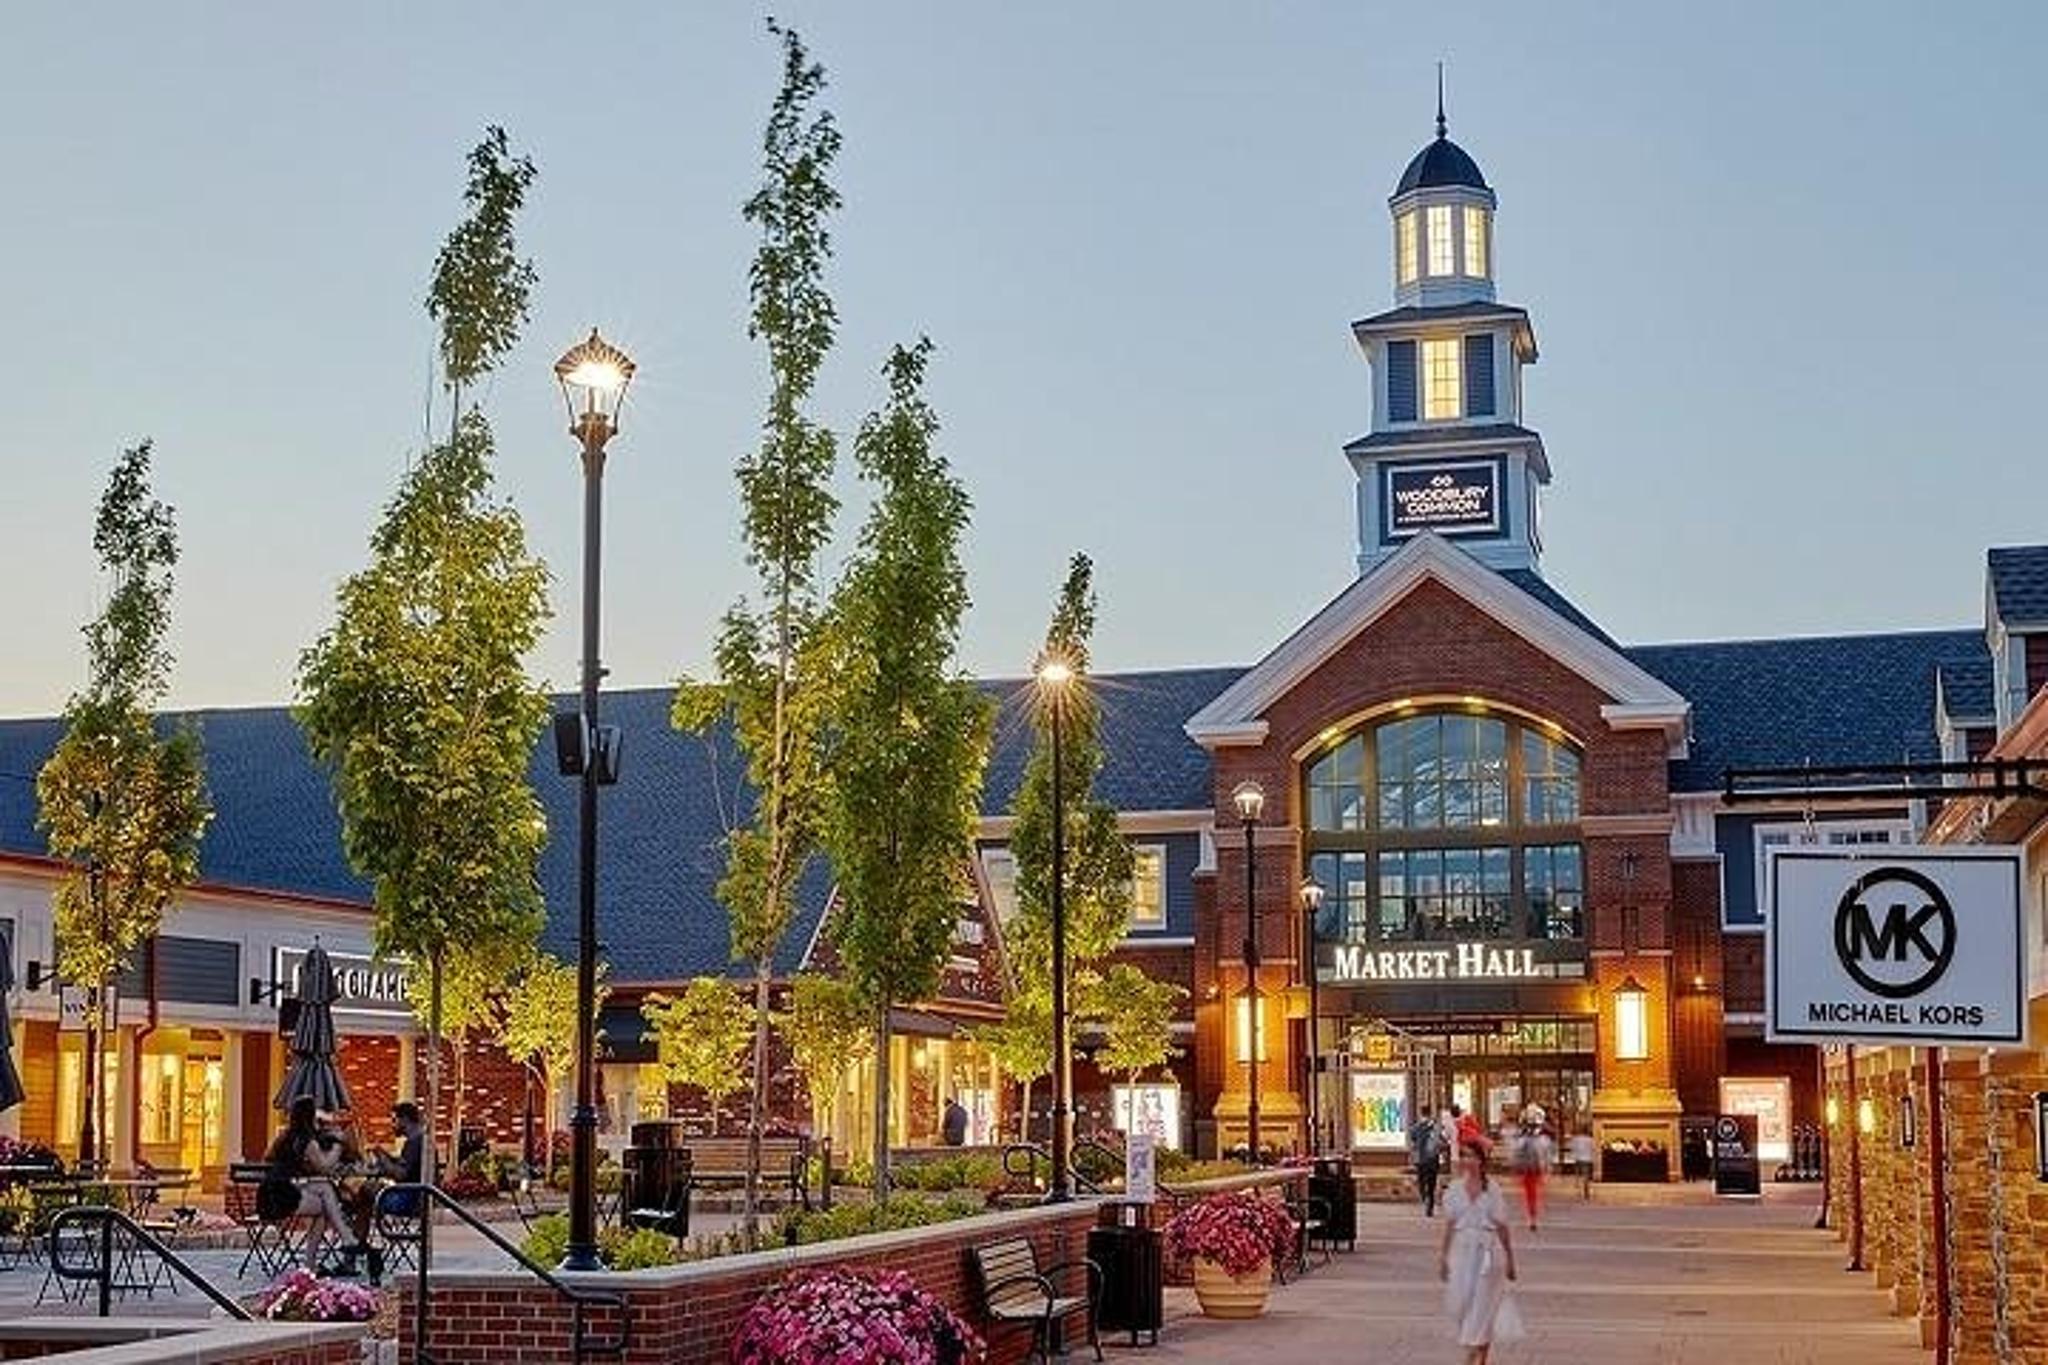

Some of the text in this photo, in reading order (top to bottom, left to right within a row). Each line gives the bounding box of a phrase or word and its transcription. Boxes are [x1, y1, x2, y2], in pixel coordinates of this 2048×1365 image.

[1396, 486, 1488, 504] WOODBURY
[1407, 499, 1480, 515] COMMON
[1850, 903, 1940, 962] MK
[1335, 943, 1539, 979] MARKET HALL
[1808, 1002, 1984, 1026] MICHAEL KORS
